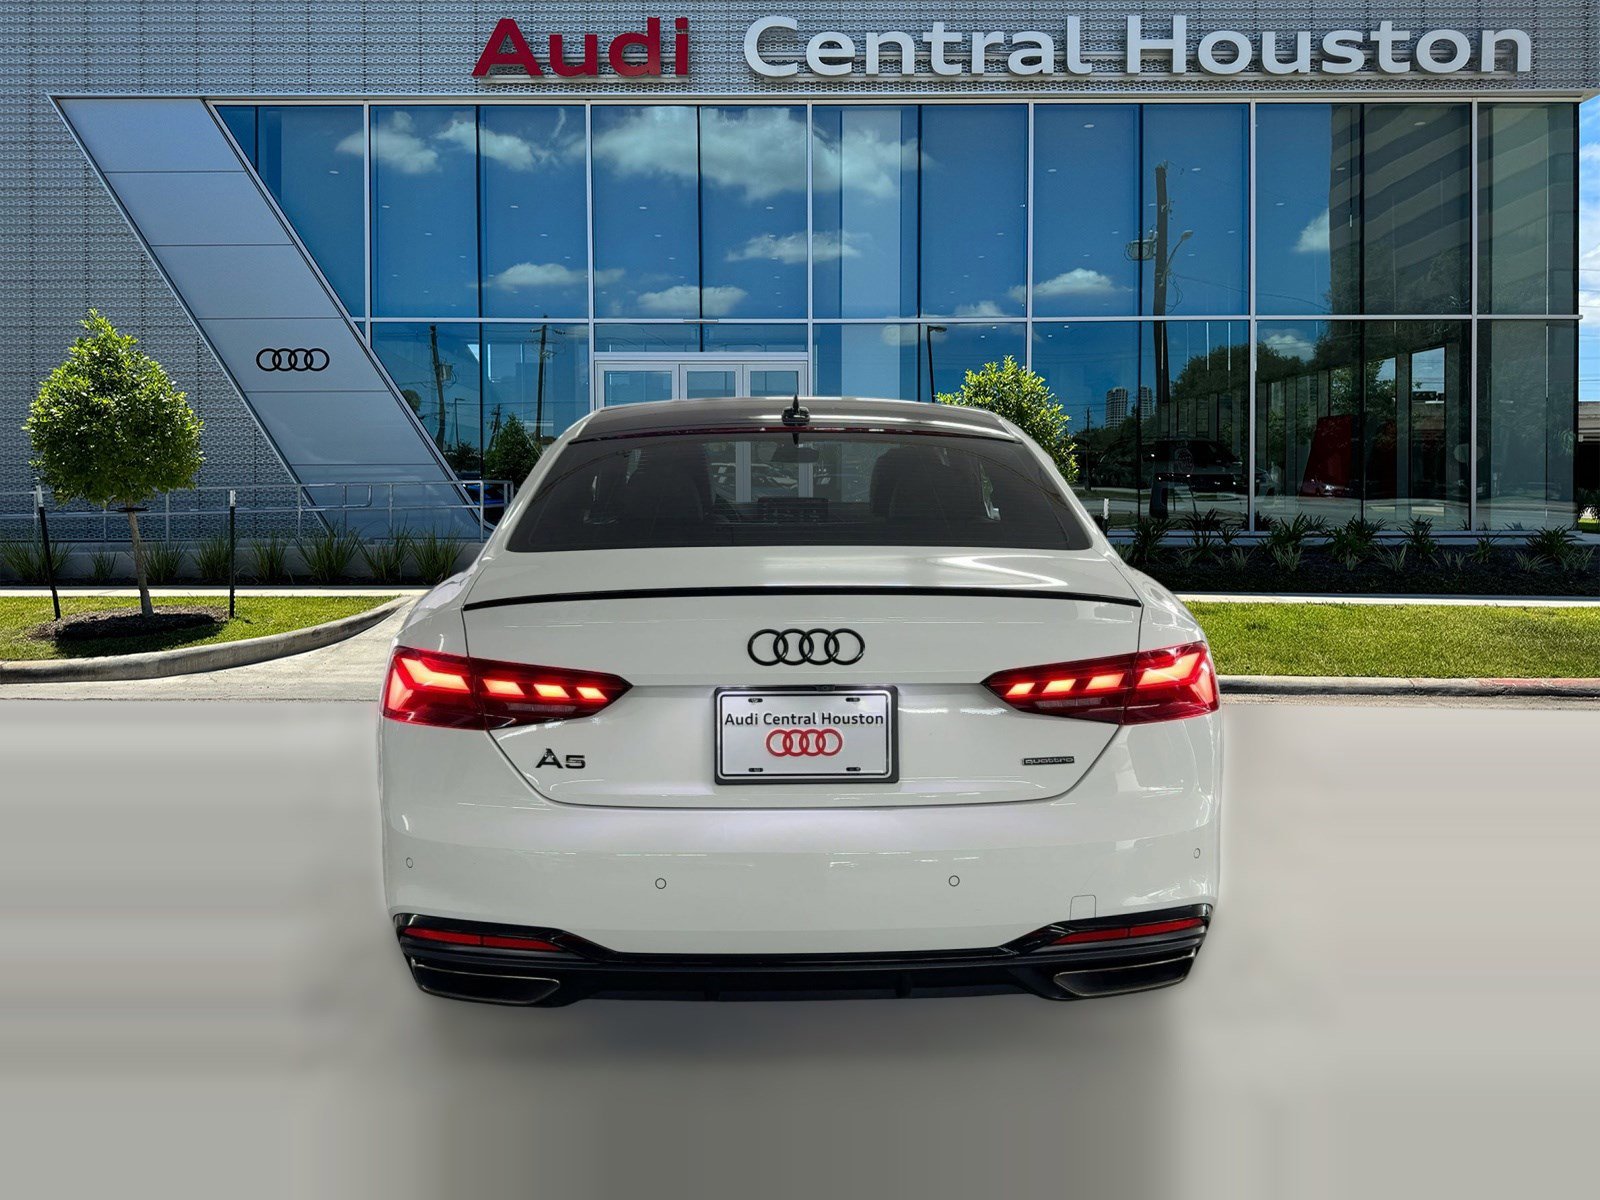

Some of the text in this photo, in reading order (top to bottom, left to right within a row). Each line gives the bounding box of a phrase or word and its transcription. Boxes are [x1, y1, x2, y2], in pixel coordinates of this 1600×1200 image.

[472, 14, 1533, 78] Audi Central Houston
[724, 712, 884, 726] Audi Central Houston
[535, 747, 586, 770] A5
[1024, 757, 1074, 765] quattro
